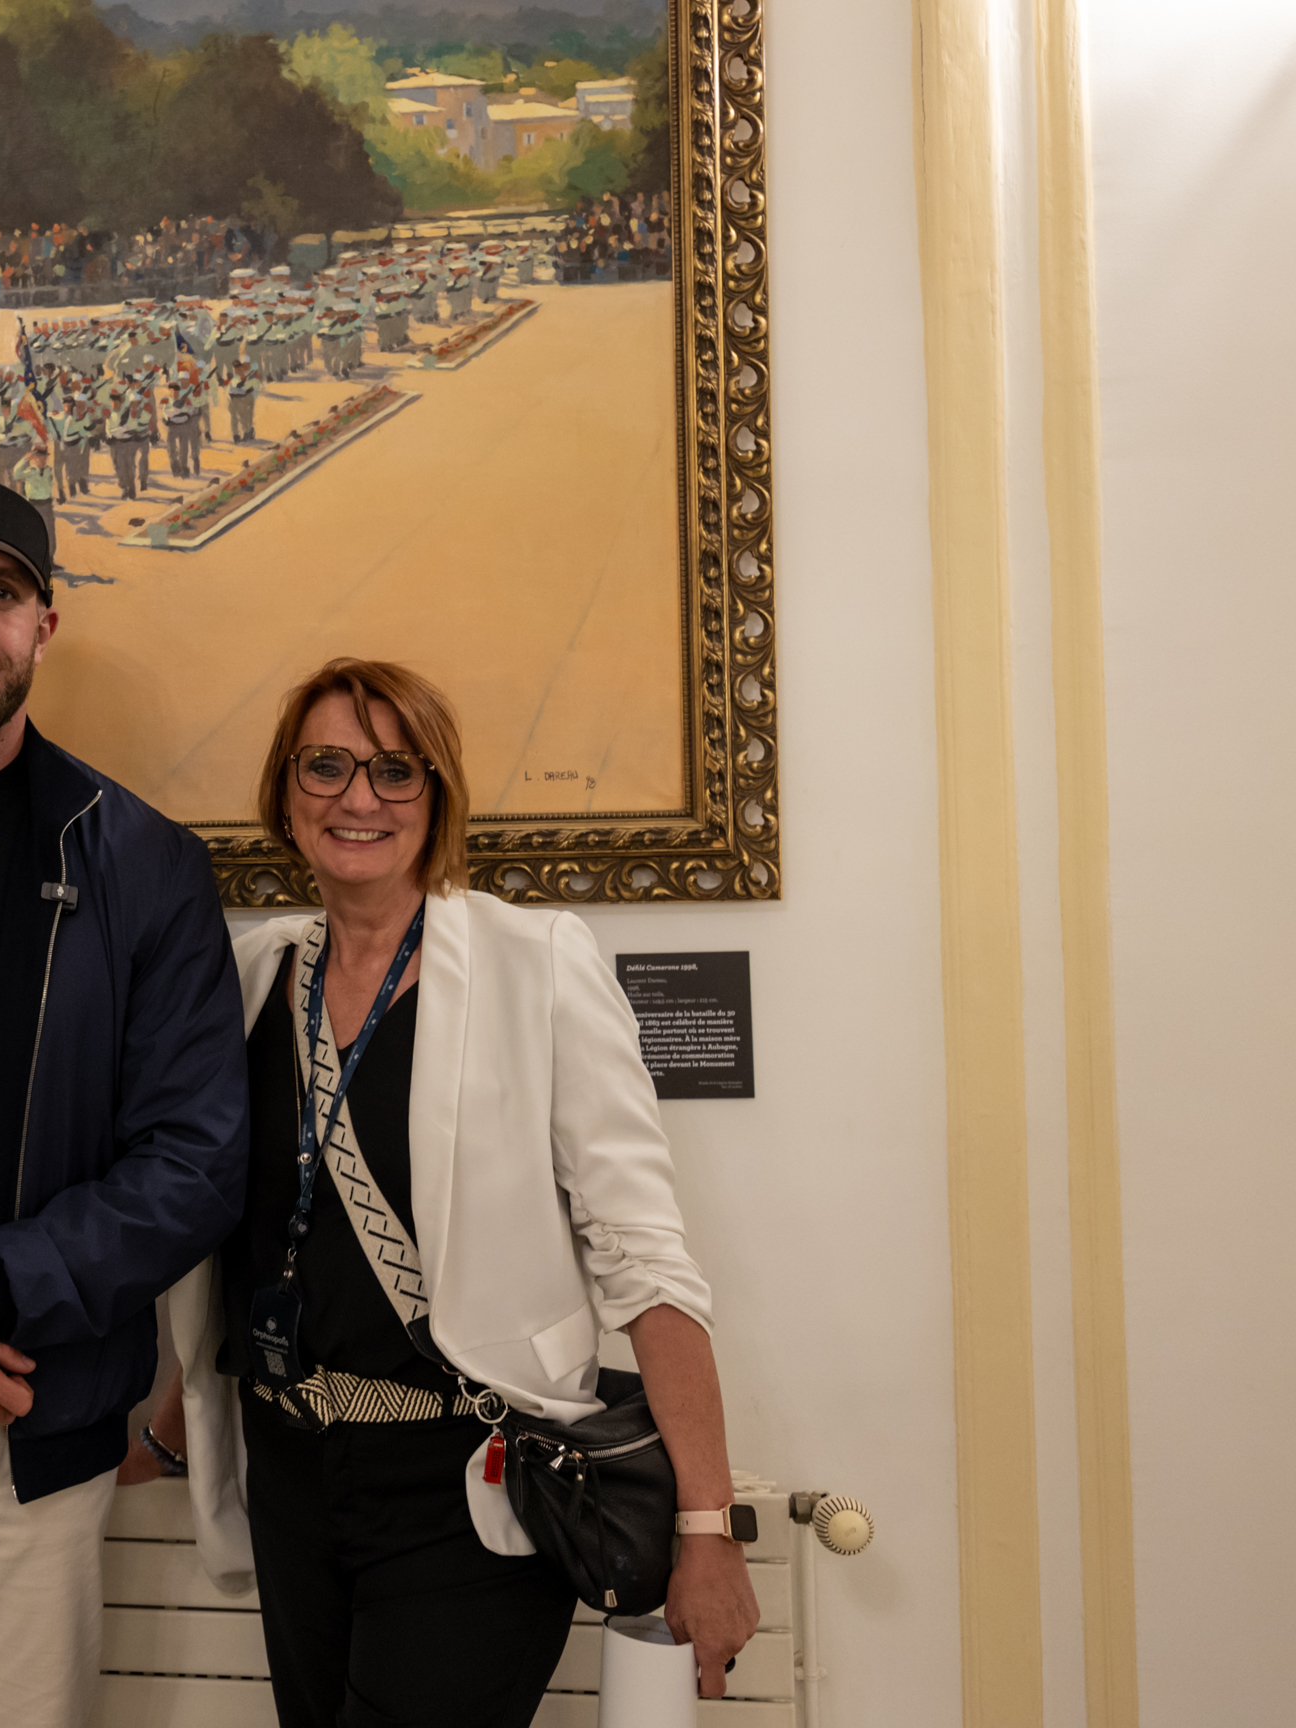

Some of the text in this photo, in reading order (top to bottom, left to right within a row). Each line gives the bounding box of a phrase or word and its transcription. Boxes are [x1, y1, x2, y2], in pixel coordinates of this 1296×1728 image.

[663, 1028, 687, 1036] partout
[642, 1036, 683, 1045] légionnaires.
[646, 1044, 667, 1052] Légion
[670, 1044, 700, 1052] étrangère
[708, 1043, 738, 1051] Aubagne,
[651, 1061, 668, 1069] place
[669, 1060, 690, 1068] devant
